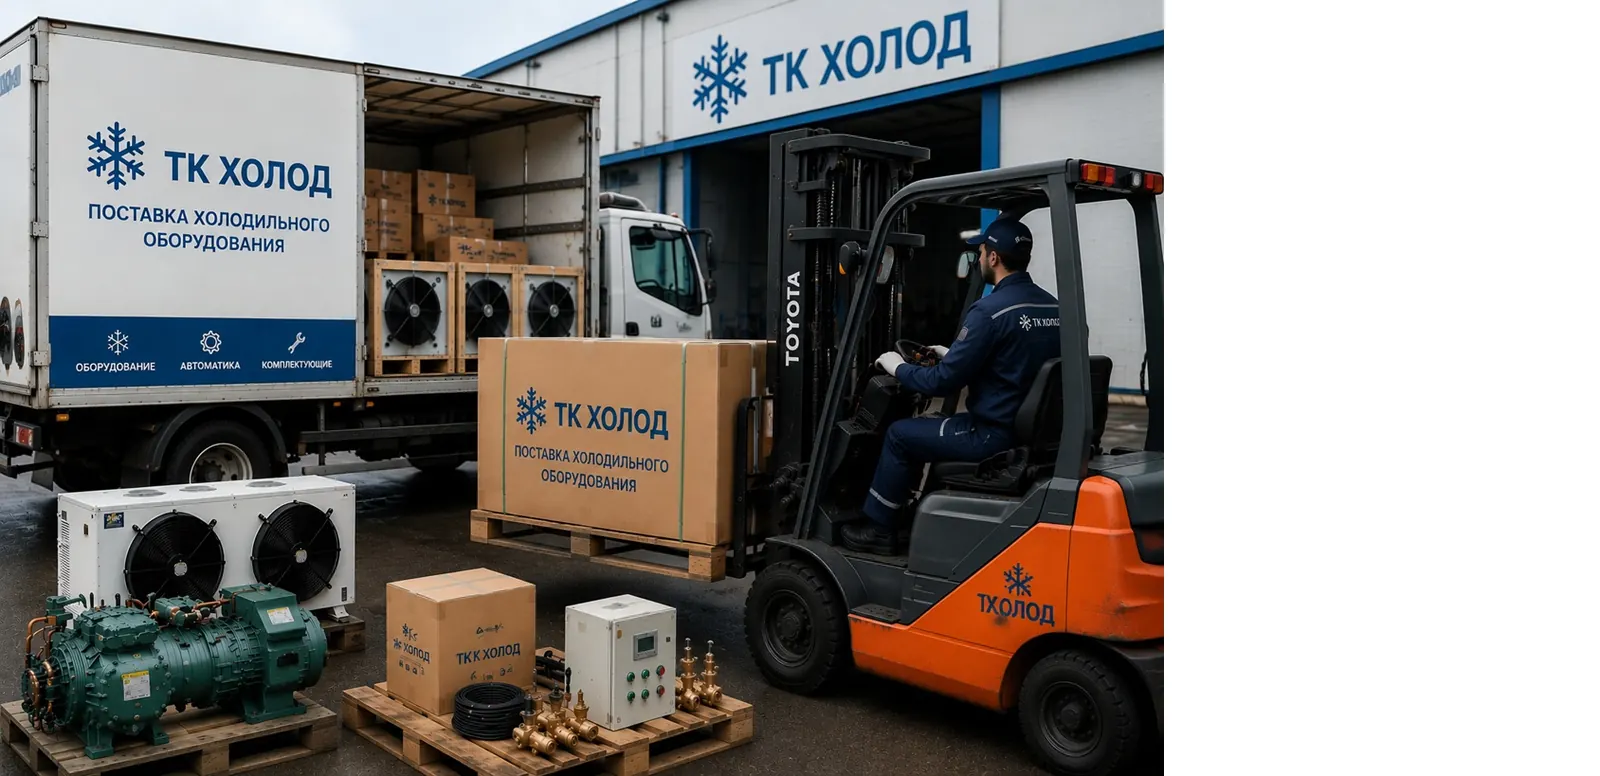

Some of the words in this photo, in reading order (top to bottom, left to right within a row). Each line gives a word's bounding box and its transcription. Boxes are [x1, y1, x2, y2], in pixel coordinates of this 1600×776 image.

[761, 48, 809, 95] ТК
[820, 10, 972, 86] ХОЛОД
[164, 150, 210, 184] ТК
[218, 156, 333, 199] ХОЛОД
[88, 203, 189, 224] ПОСТАВКА
[194, 210, 330, 233] ХОЛОДИЛЬНОГО
[143, 232, 285, 253] ОБОРУДОВАНИЯ
[785, 271, 800, 366] TOYOTA
[75, 362, 156, 373] ОБОРУДОВАНИЕ
[180, 361, 241, 371] АВТОМАТИКА
[261, 359, 333, 370] КОМПЛЕКТУЮЩИЕ
[554, 402, 582, 428] ТК
[587, 404, 669, 441] ХОЛОД
[514, 445, 570, 464] ПОСТАВКА
[573, 450, 669, 473] ХОЛОДИЛЬНОГО
[541, 469, 637, 493] ОБОРУДОВАНИЯ
[483, 643, 520, 660] ХОЛОД
